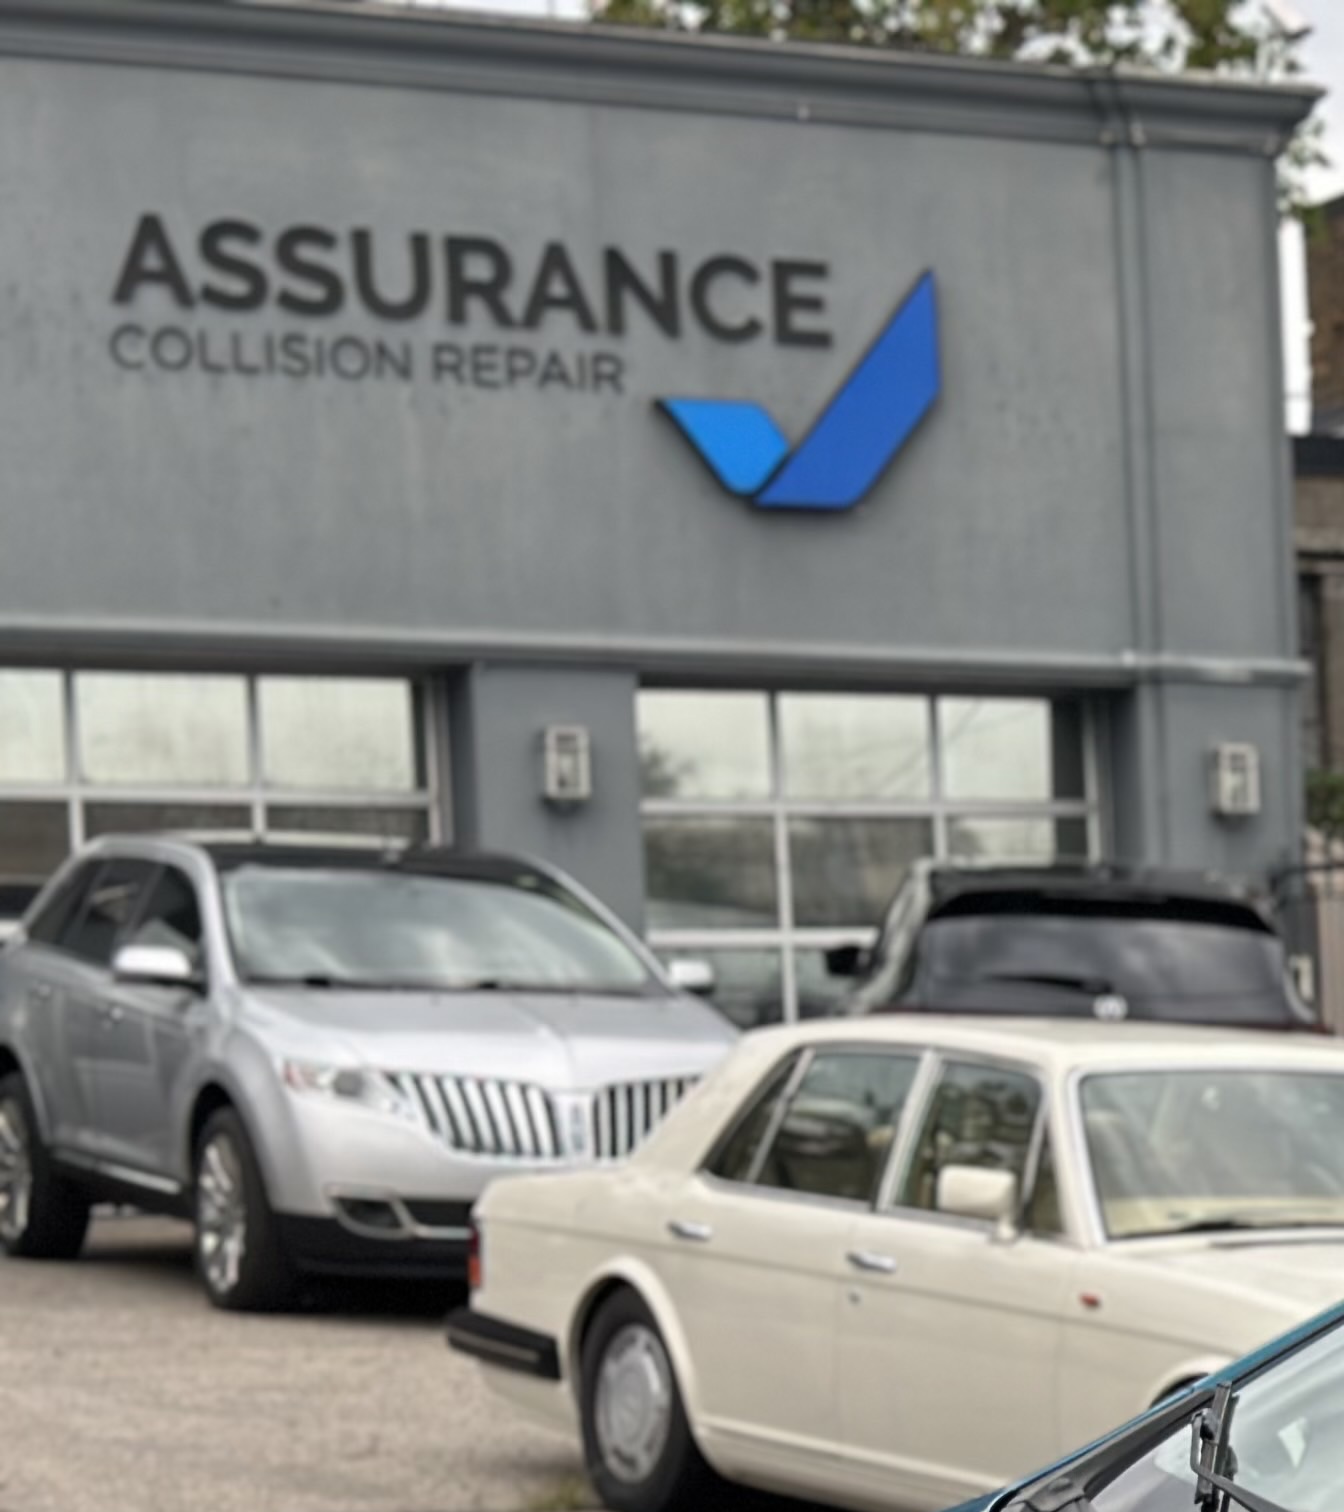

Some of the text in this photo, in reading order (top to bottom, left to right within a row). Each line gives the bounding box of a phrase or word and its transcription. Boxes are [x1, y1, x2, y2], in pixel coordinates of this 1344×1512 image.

[112, 213, 832, 350] ASSURANCE
[108, 324, 626, 395] COLLISION REPAIR
